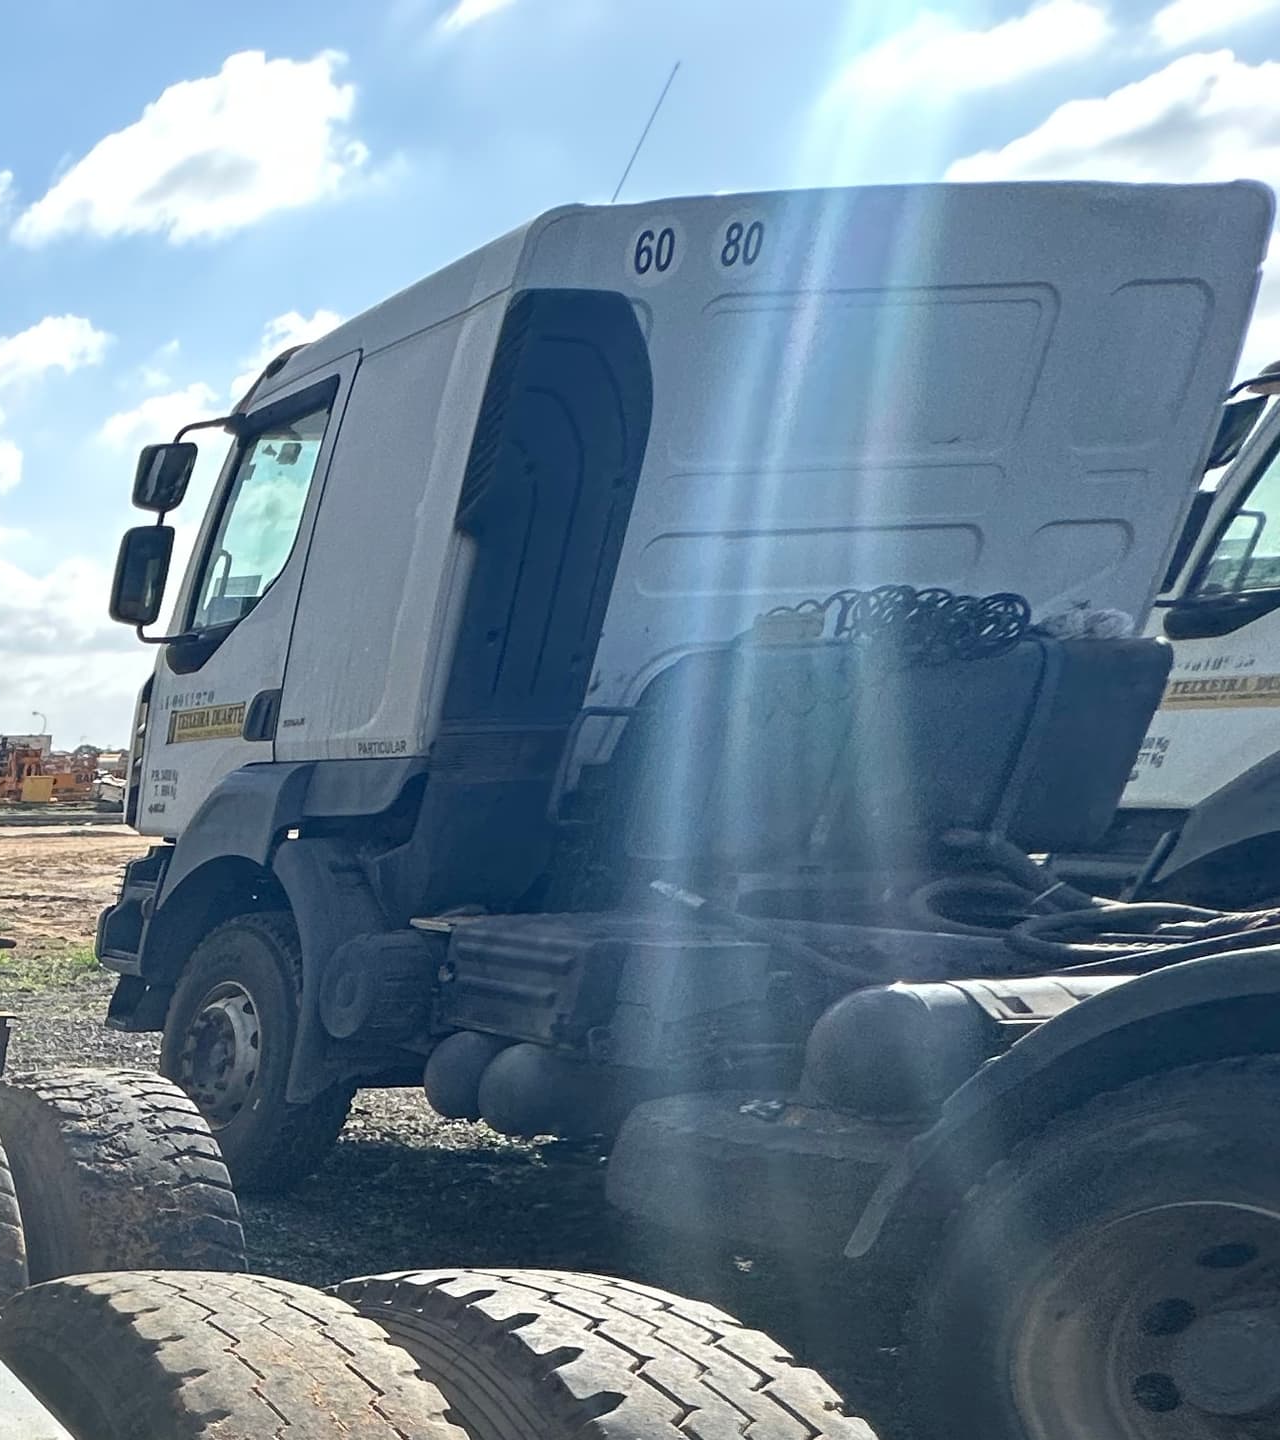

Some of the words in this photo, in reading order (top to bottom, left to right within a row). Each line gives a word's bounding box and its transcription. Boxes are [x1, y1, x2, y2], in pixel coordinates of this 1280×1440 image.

[634, 227, 676, 275] 60
[720, 220, 764, 267] 80
[357, 740, 407, 754] PARTICULAR
